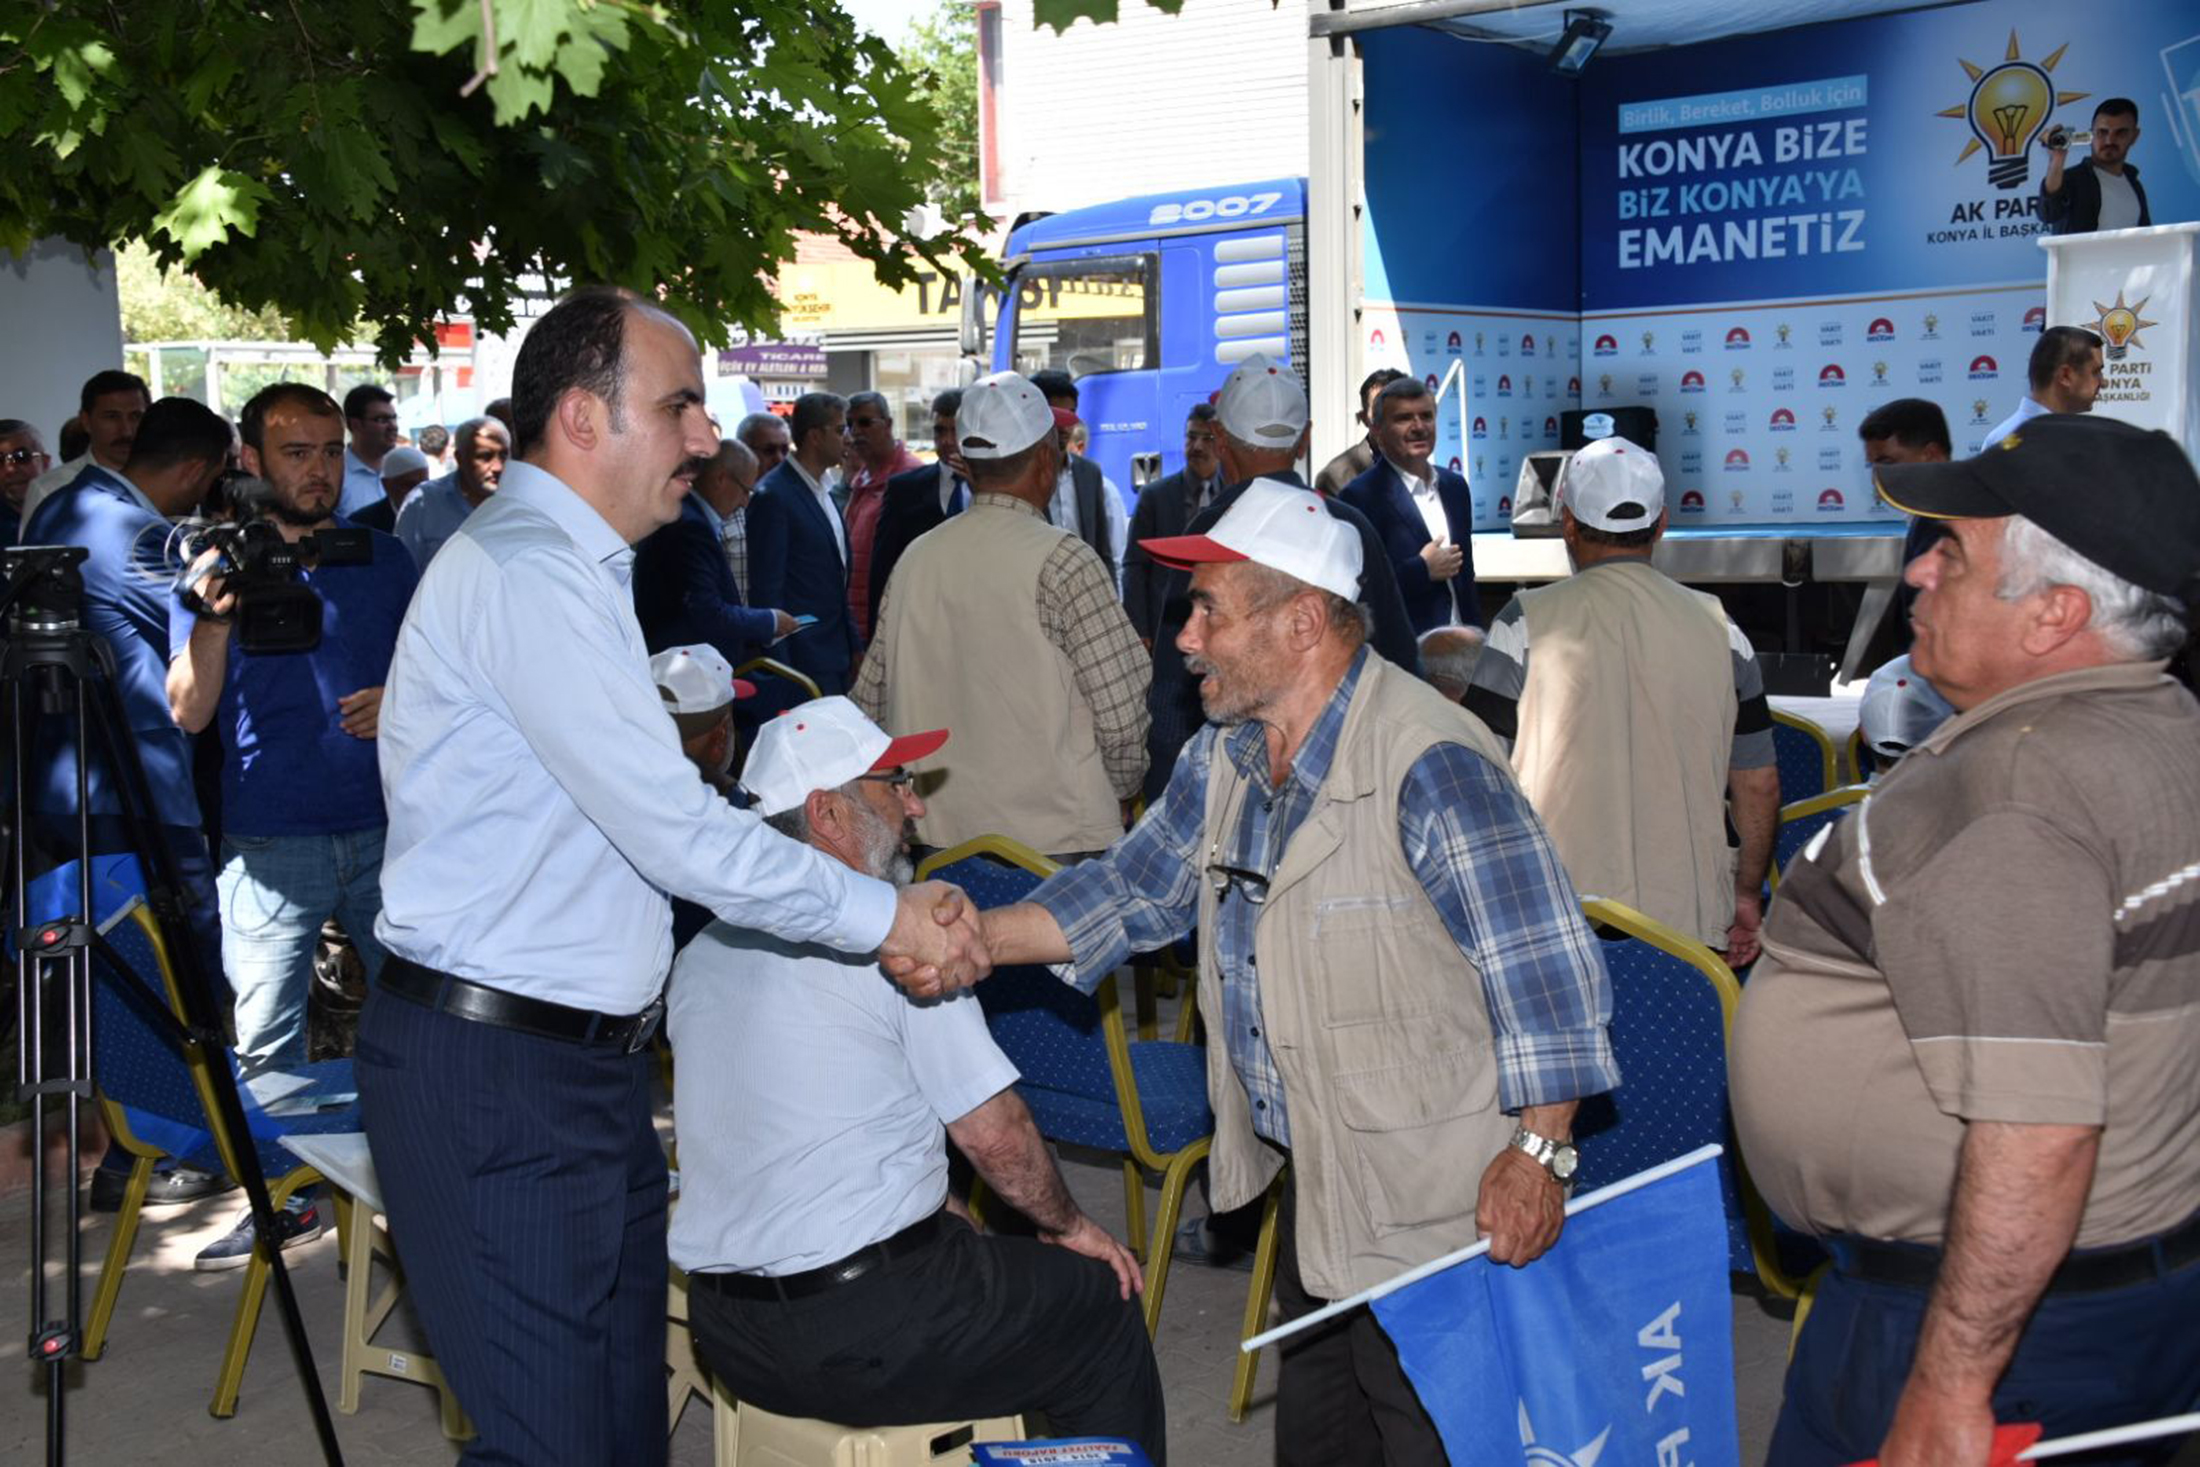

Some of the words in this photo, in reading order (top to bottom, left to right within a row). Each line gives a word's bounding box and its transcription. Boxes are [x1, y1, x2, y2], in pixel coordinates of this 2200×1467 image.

[1623, 110, 1675, 129] Birlik,
[1680, 101, 1756, 121] Bereket,
[1761, 90, 1822, 112] Bolluk
[1827, 83, 1862, 104] için
[1618, 132, 1763, 179] KONYA
[1149, 191, 1283, 225] 2007
[1951, 200, 1986, 224] AK
[1994, 196, 2042, 220] PAR
[1926, 229, 1978, 244] KONYA
[2000, 222, 2051, 238] BAŞKA
[2099, 378, 2141, 389] ONYA
